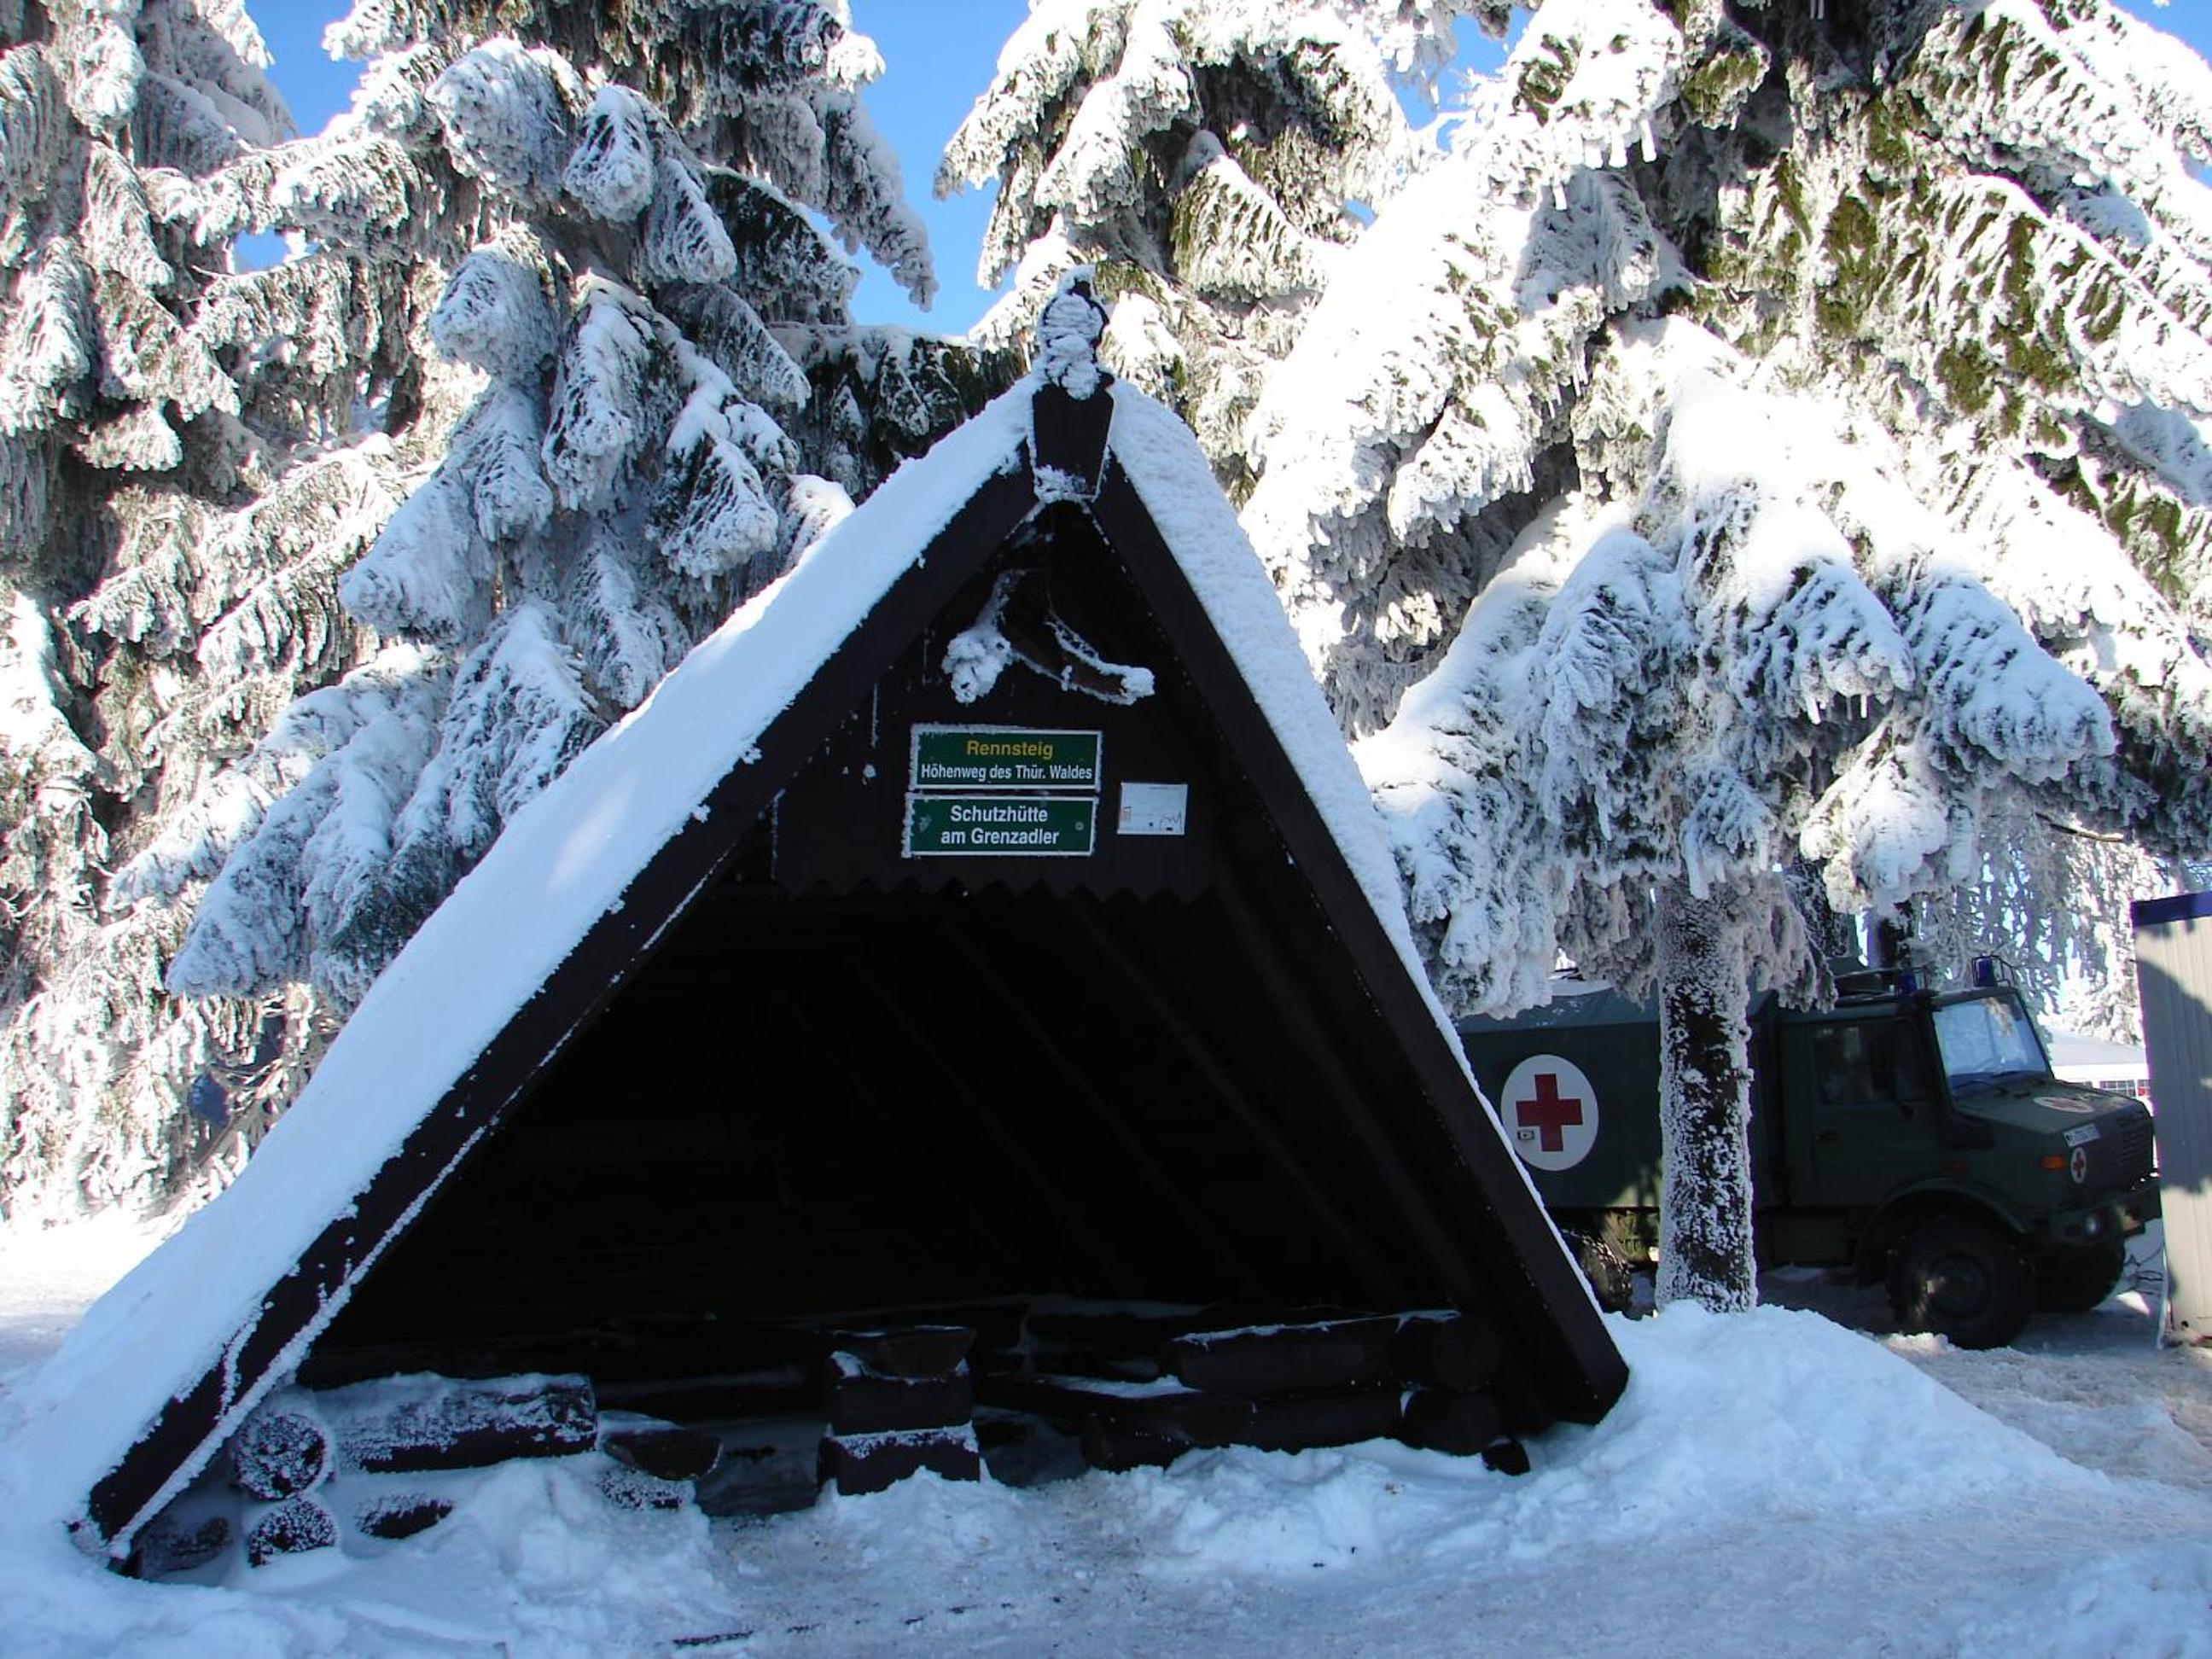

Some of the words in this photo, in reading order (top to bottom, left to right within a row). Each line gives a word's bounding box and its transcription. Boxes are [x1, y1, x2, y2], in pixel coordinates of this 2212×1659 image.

[966, 740, 1053, 760] Rennsteig
[921, 763, 987, 781] Höhenweg
[989, 764, 1011, 778] des
[1015, 764, 1046, 779] Thür.
[1050, 765, 1092, 779] Waldes
[951, 804, 1048, 823] Schutzhütte
[940, 830, 965, 845] am
[971, 828, 1059, 846] Grenzadler
